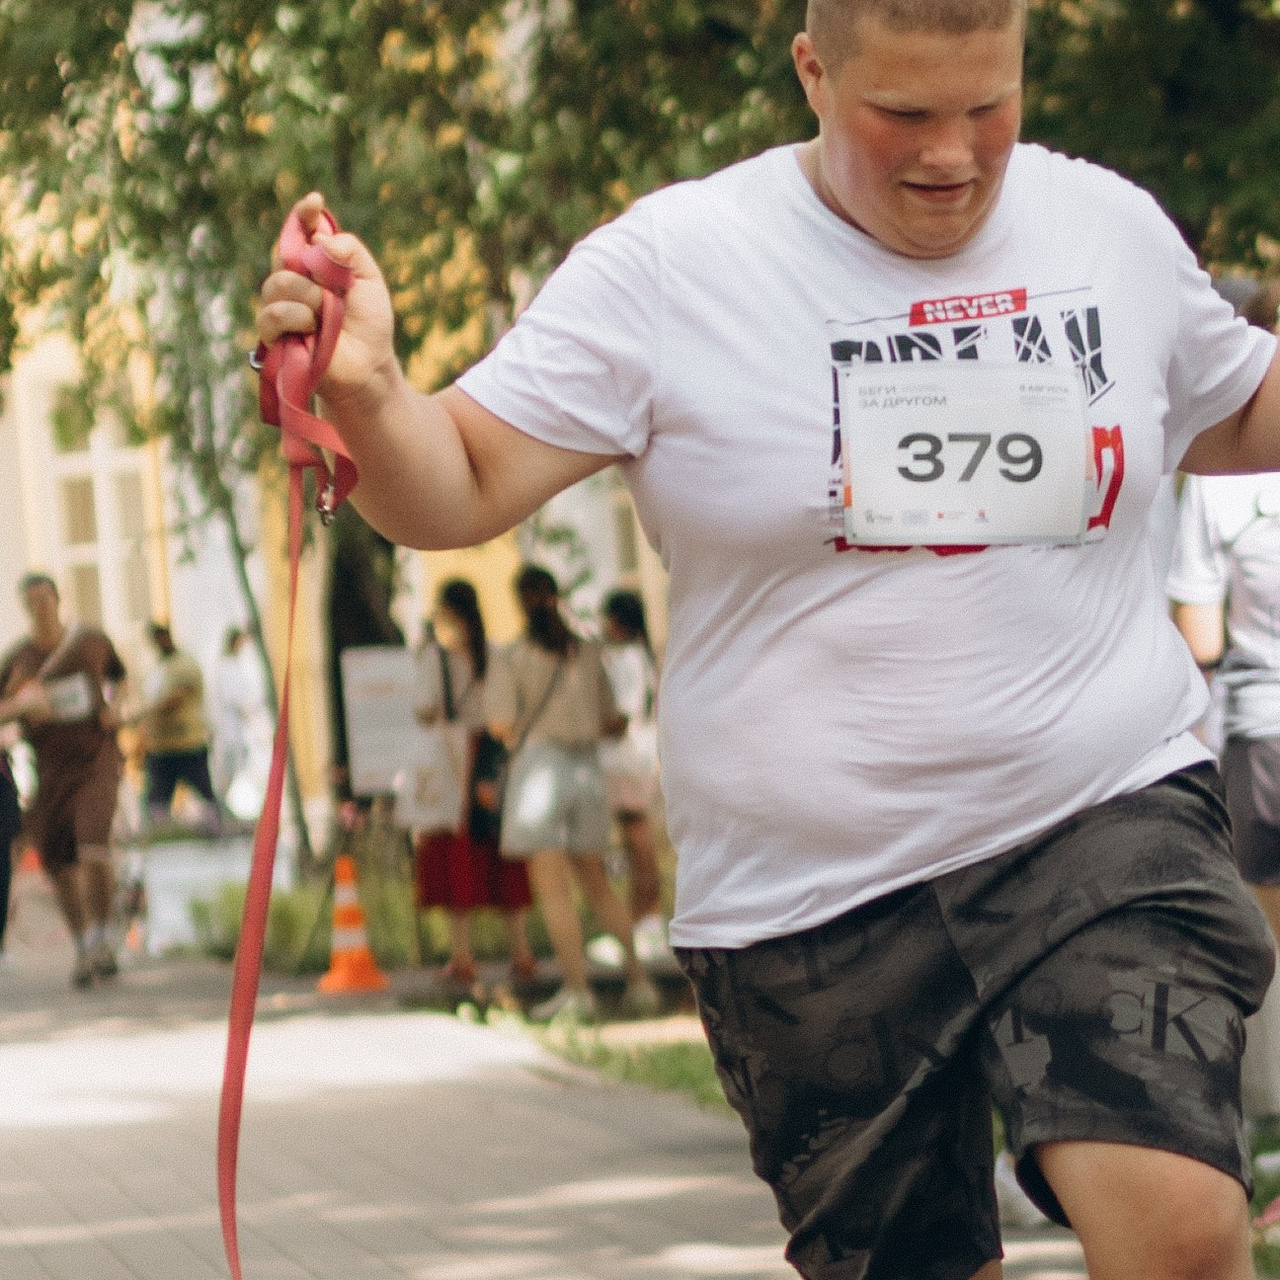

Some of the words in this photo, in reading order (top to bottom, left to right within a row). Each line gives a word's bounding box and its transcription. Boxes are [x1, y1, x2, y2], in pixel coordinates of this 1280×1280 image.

[922, 292, 1016, 322] NEVER
[882, 395, 947, 409] ДРУГОМ
[896, 432, 1043, 483] 379
